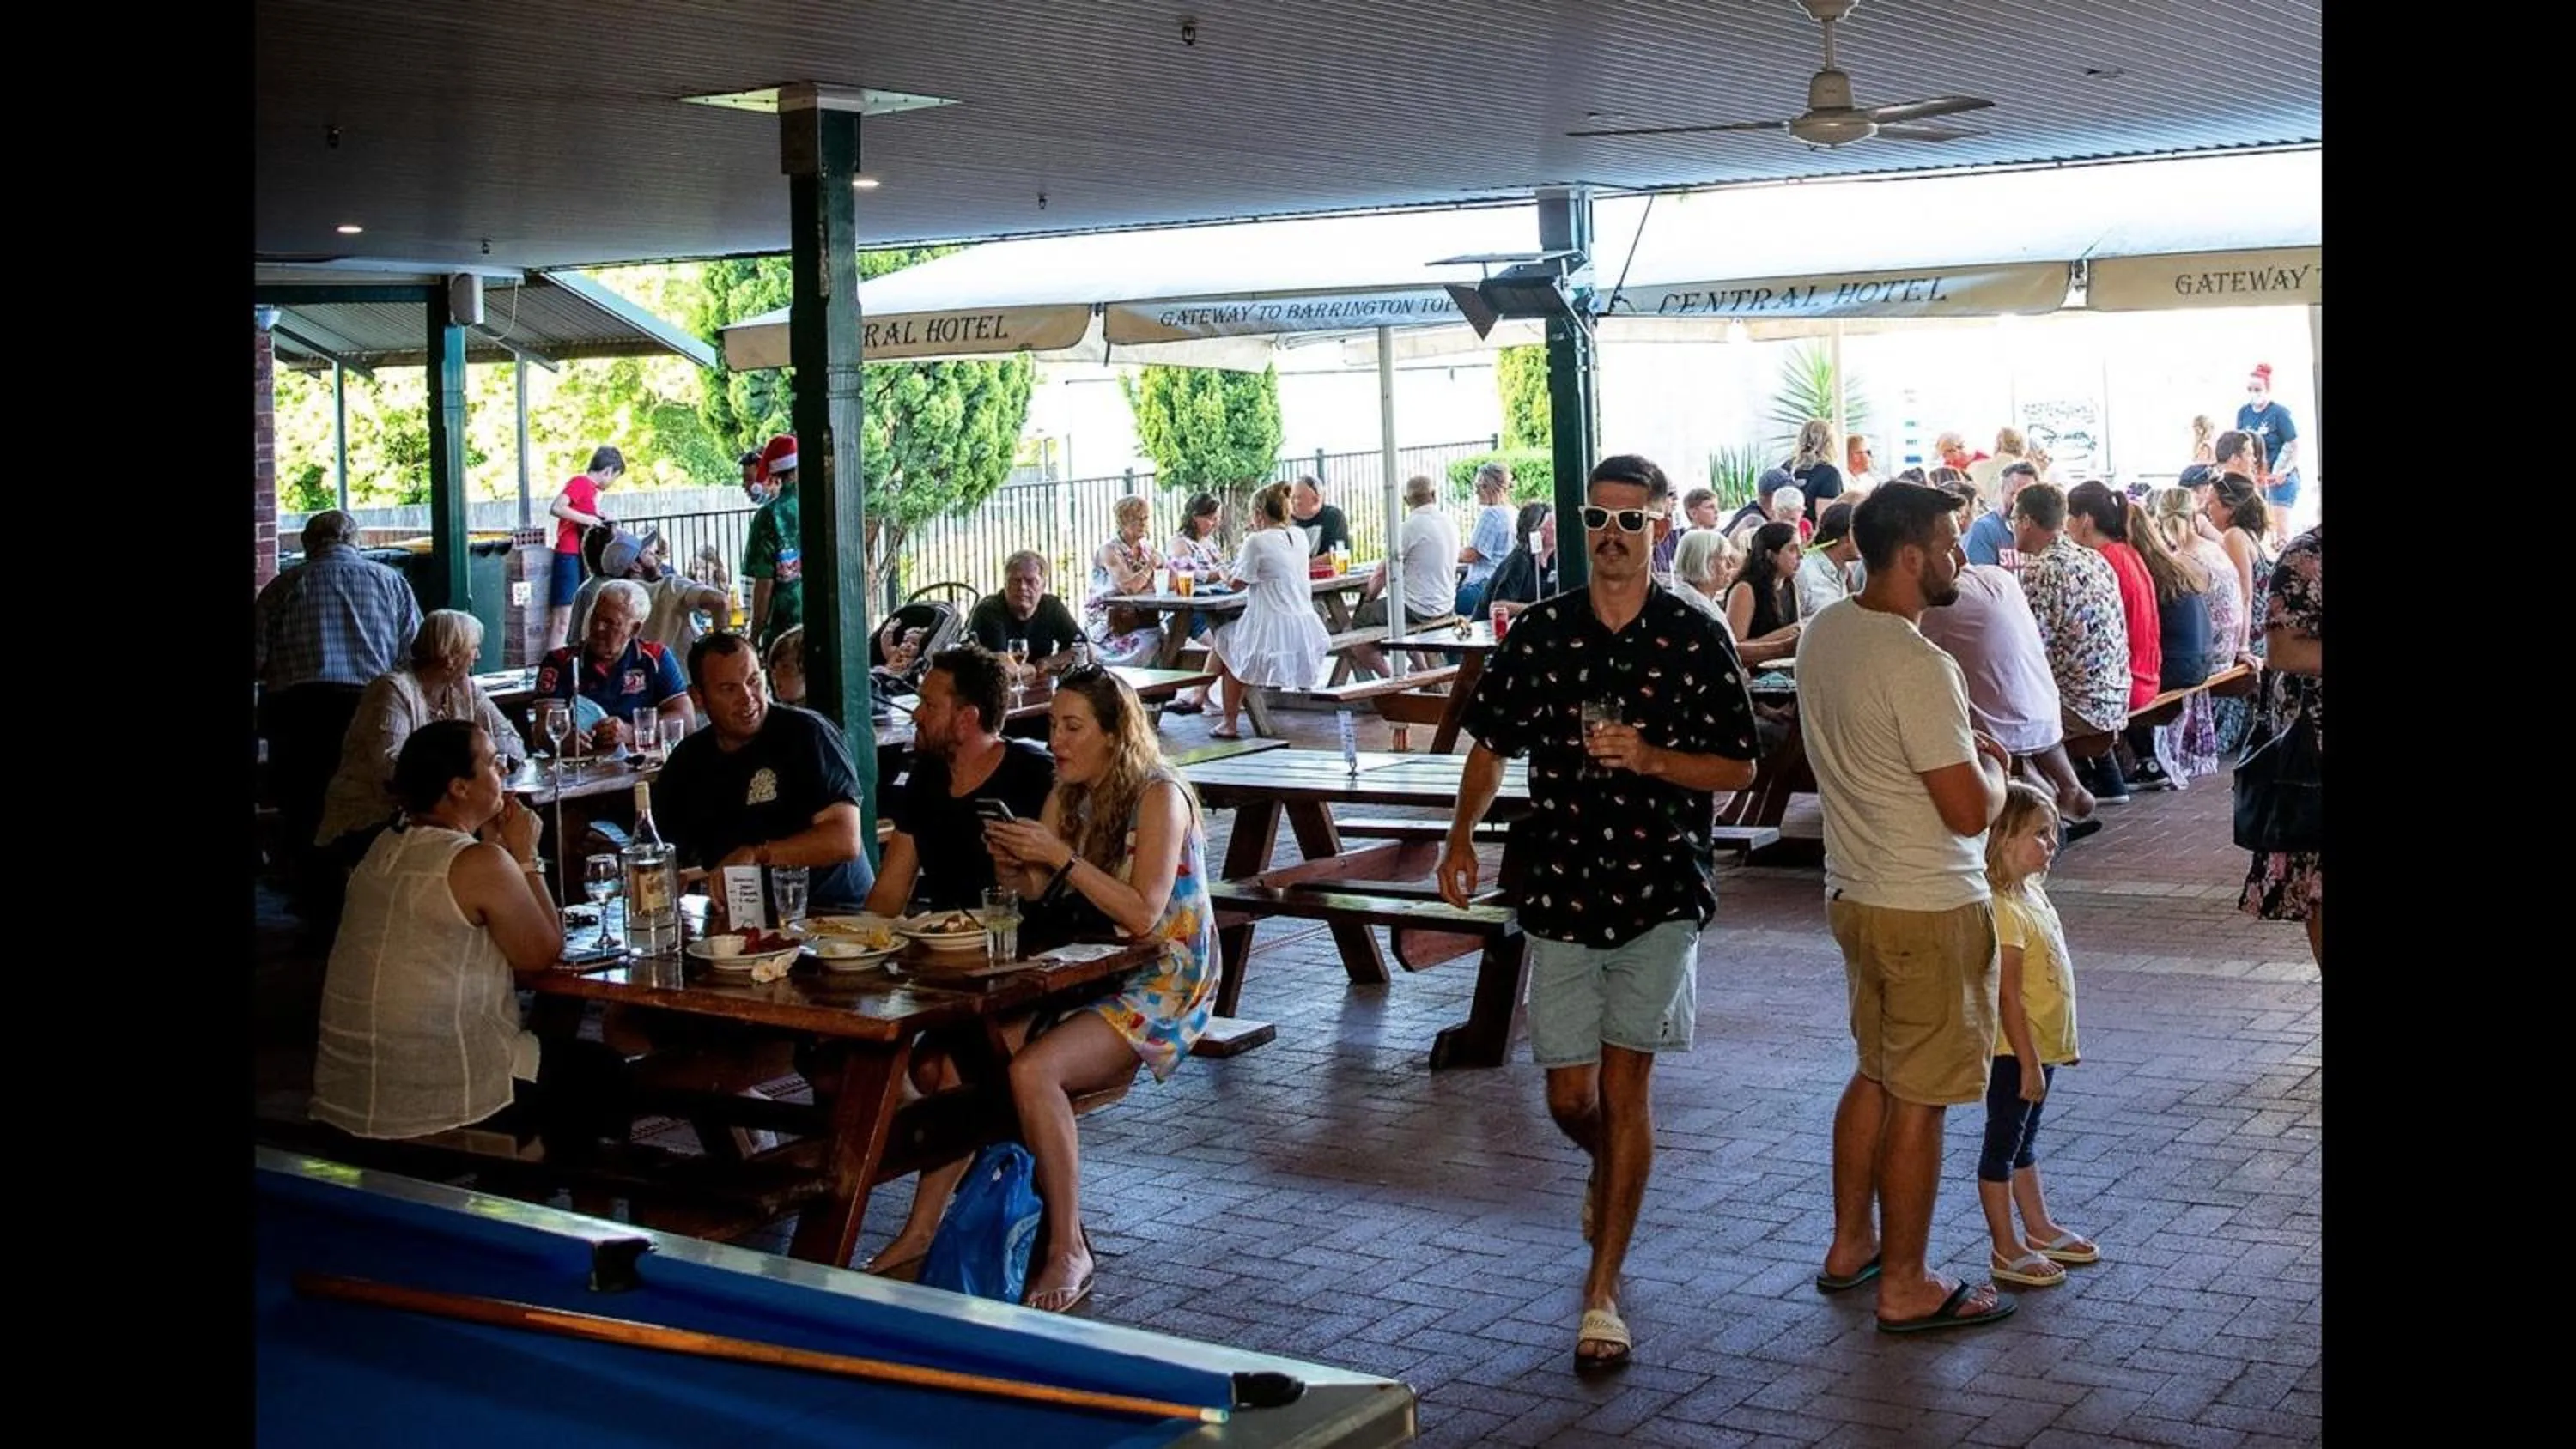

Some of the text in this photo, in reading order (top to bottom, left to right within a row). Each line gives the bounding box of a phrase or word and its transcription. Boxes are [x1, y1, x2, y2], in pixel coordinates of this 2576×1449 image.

[1657, 276, 1948, 315] CENTRAL HOTEL
[2174, 264, 2311, 296] GATEWAY
[1160, 297, 1460, 328] GATEWAY TO BARRINGTON TOP
[862, 314, 1009, 349] RAL HOTEL
